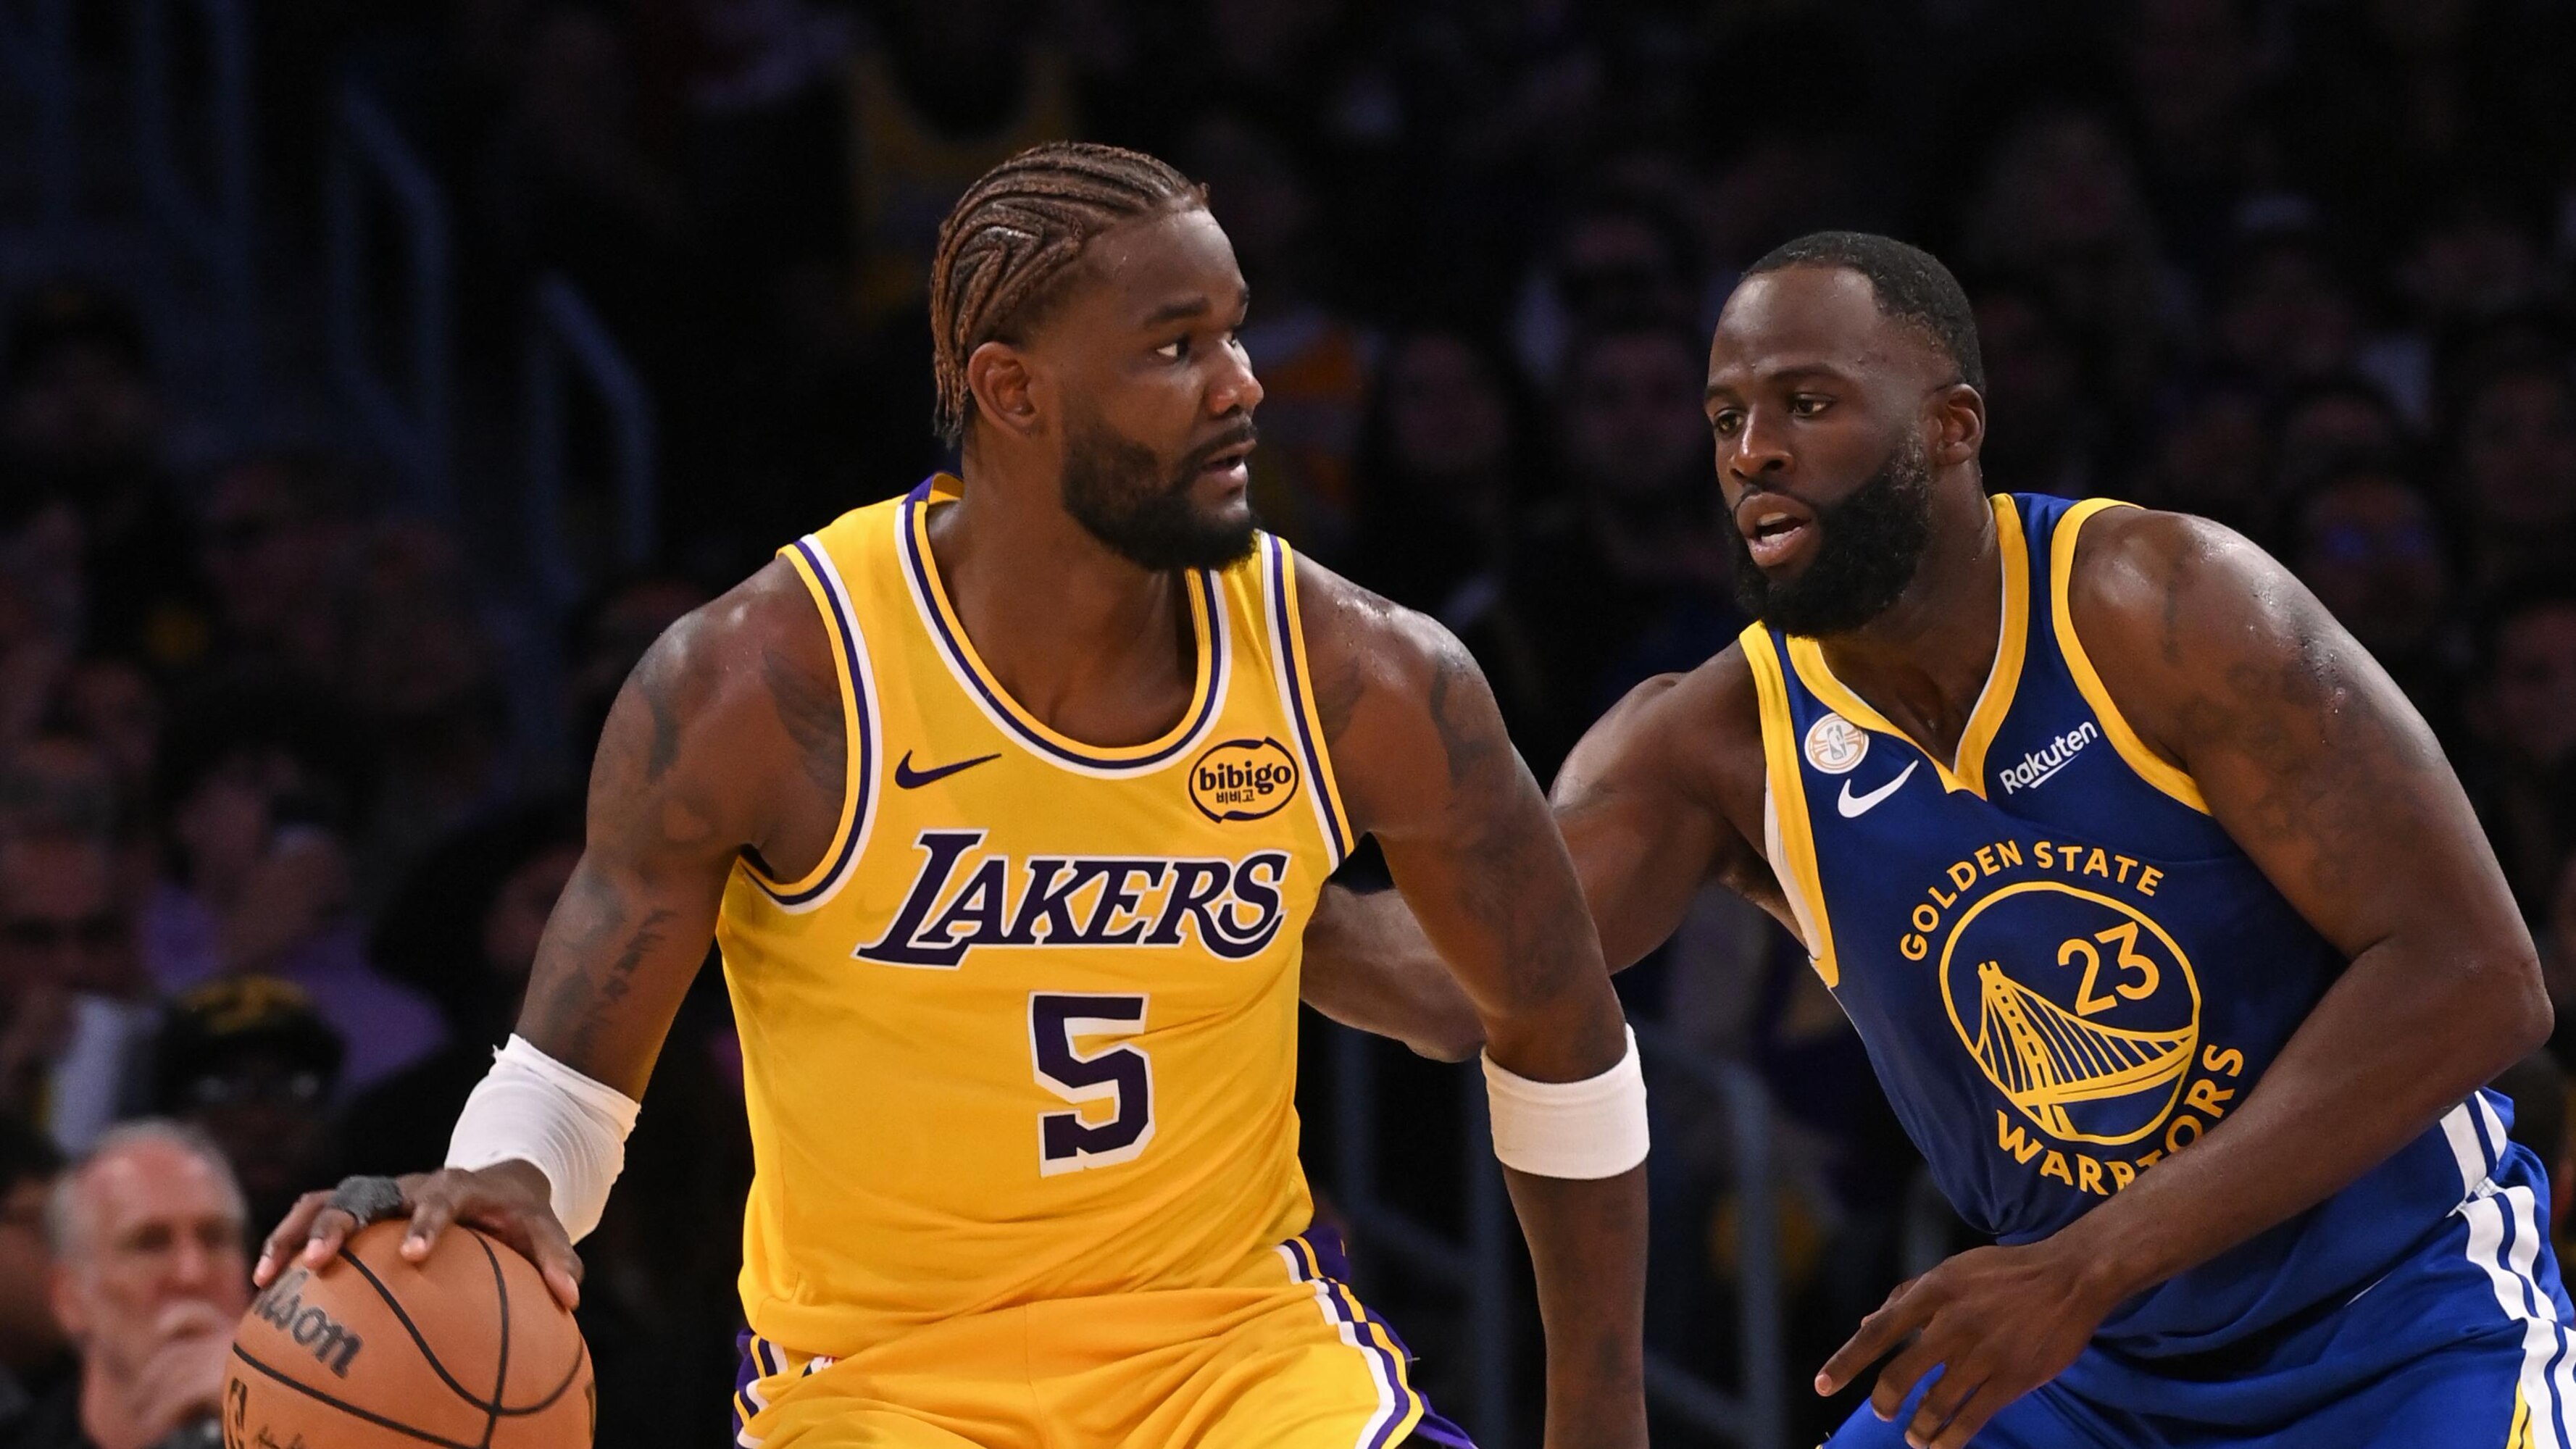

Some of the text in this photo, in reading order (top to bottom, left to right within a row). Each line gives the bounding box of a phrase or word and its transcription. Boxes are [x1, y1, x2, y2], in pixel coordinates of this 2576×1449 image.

[1199, 760, 1291, 795] bibigo
[1216, 789, 1255, 804] 비비고
[1999, 722, 2098, 795] Rakuten
[851, 828, 1292, 969] LAKERS
[1900, 840, 2164, 961] GOLDEN STATE
[2057, 922, 2159, 1016] 23
[1028, 992, 1155, 1177] 5
